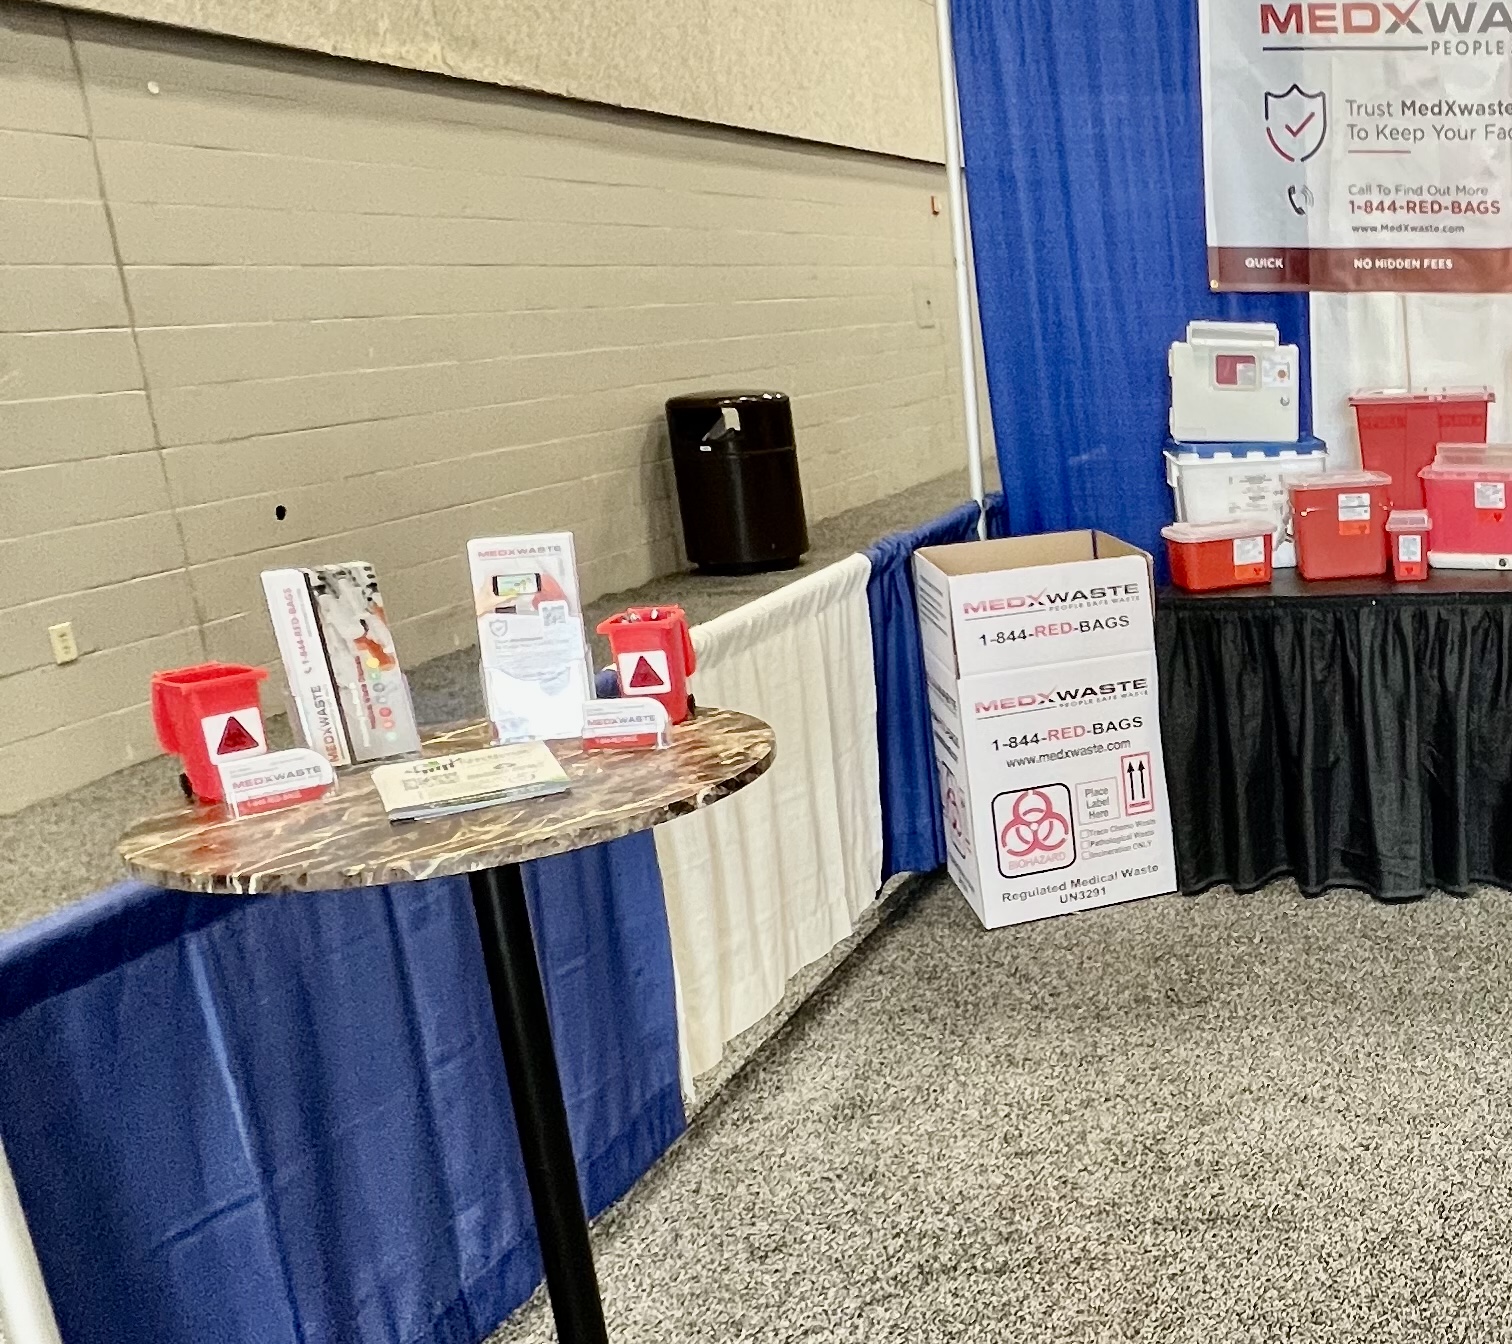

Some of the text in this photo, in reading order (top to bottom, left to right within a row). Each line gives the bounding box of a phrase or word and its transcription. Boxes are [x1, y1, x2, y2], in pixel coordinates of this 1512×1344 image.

[1431, 40, 1505, 56] PEOPLE
[1345, 99, 1393, 117] Trust
[1347, 123, 1369, 141] To
[1375, 123, 1425, 144] Keep
[1431, 123, 1477, 141] Your
[1348, 184, 1488, 197] Call To Find Out More
[1348, 199, 1501, 215] 1-844-RED-BAGS
[1351, 223, 1465, 233] www.MedXwaste.com
[1245, 257, 1284, 269] QUICK
[1353, 258, 1453, 270] NO HIDDEN FEES
[963, 583, 1139, 615] MEDXWASTE
[979, 616, 1130, 646] 1-844-RED-BAGS
[975, 678, 1148, 714] MEDXWASTE
[992, 716, 1144, 751] 1-844-RED-BAGS
[1006, 738, 1131, 768] www.medxwaste.com
[1084, 787, 1109, 798] Place
[1086, 797, 1110, 809] Label
[1088, 809, 1109, 820] Here
[1008, 852, 1066, 870] BIOHAZARD
[1002, 863, 1159, 903] Regulated Medical Waste
[1059, 887, 1106, 904] UN3291
